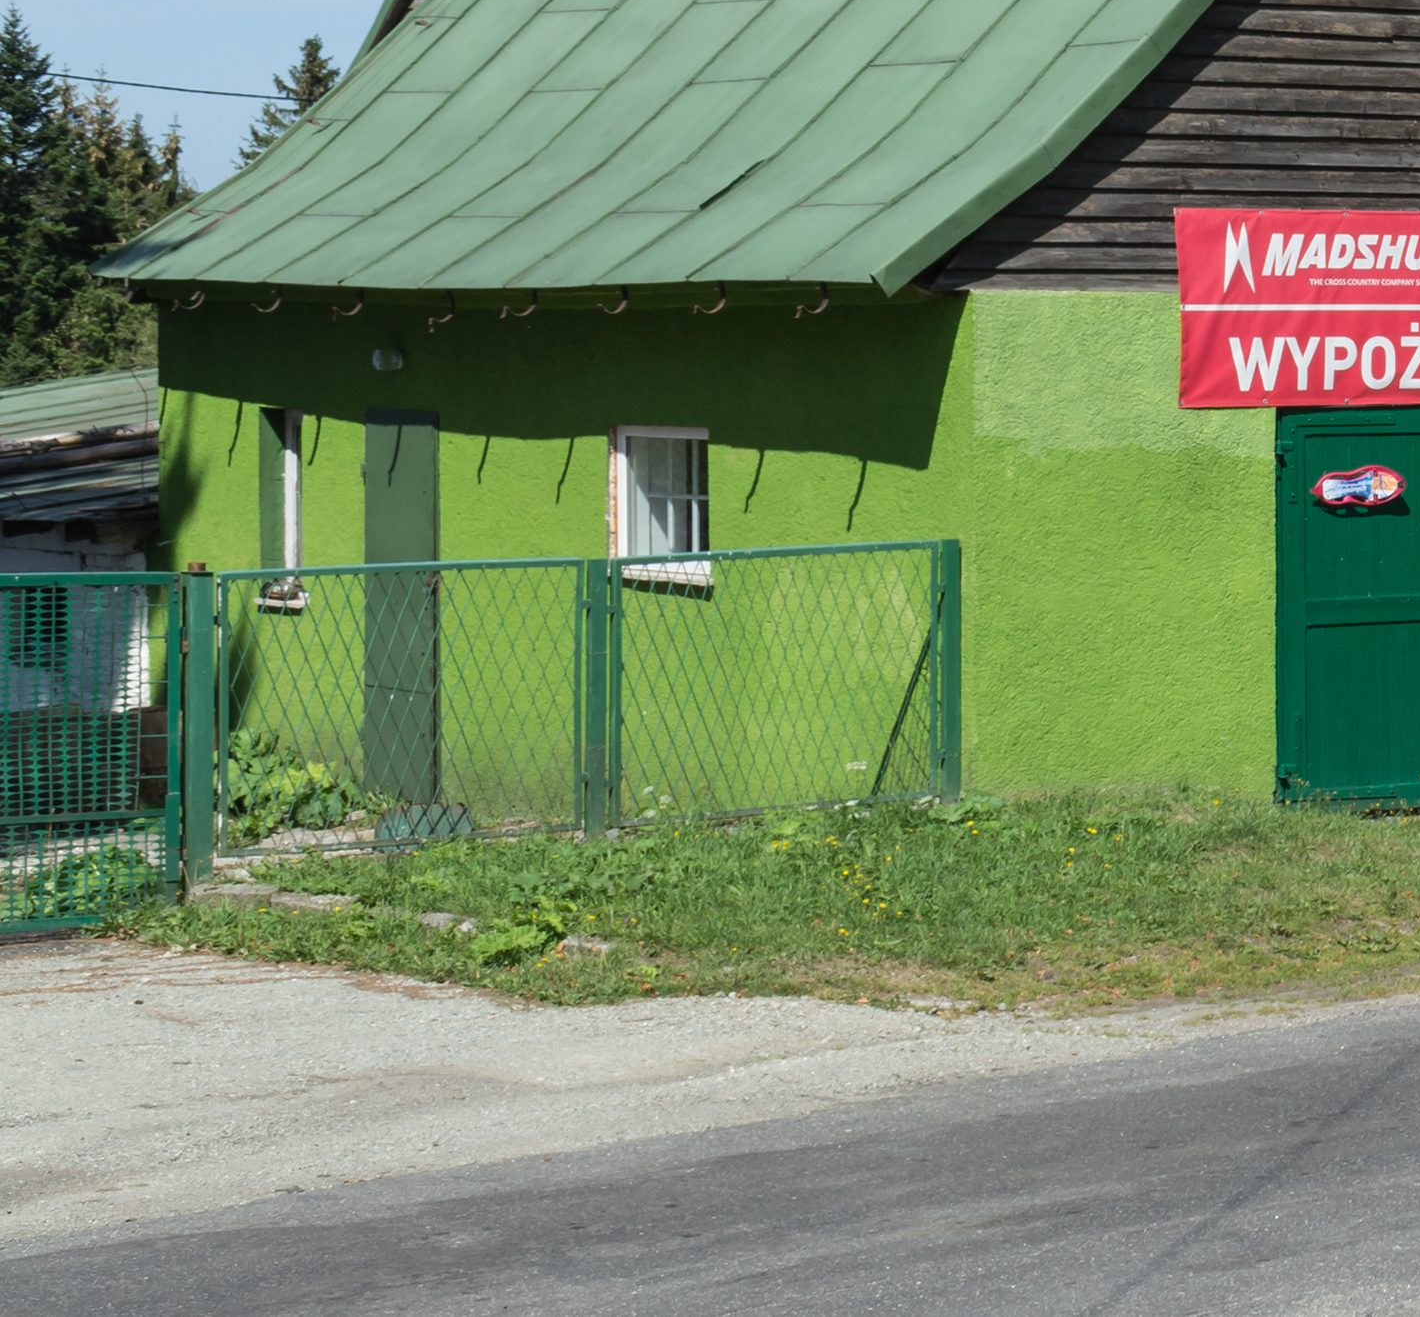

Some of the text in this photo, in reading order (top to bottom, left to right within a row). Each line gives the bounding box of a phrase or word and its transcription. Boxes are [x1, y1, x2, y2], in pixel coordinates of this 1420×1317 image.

[1309, 278, 1323, 286] THE
[1324, 278, 1346, 286] CROSS
[1347, 278, 1380, 286] COUNTRY
[1381, 278, 1414, 286] COMPANY
